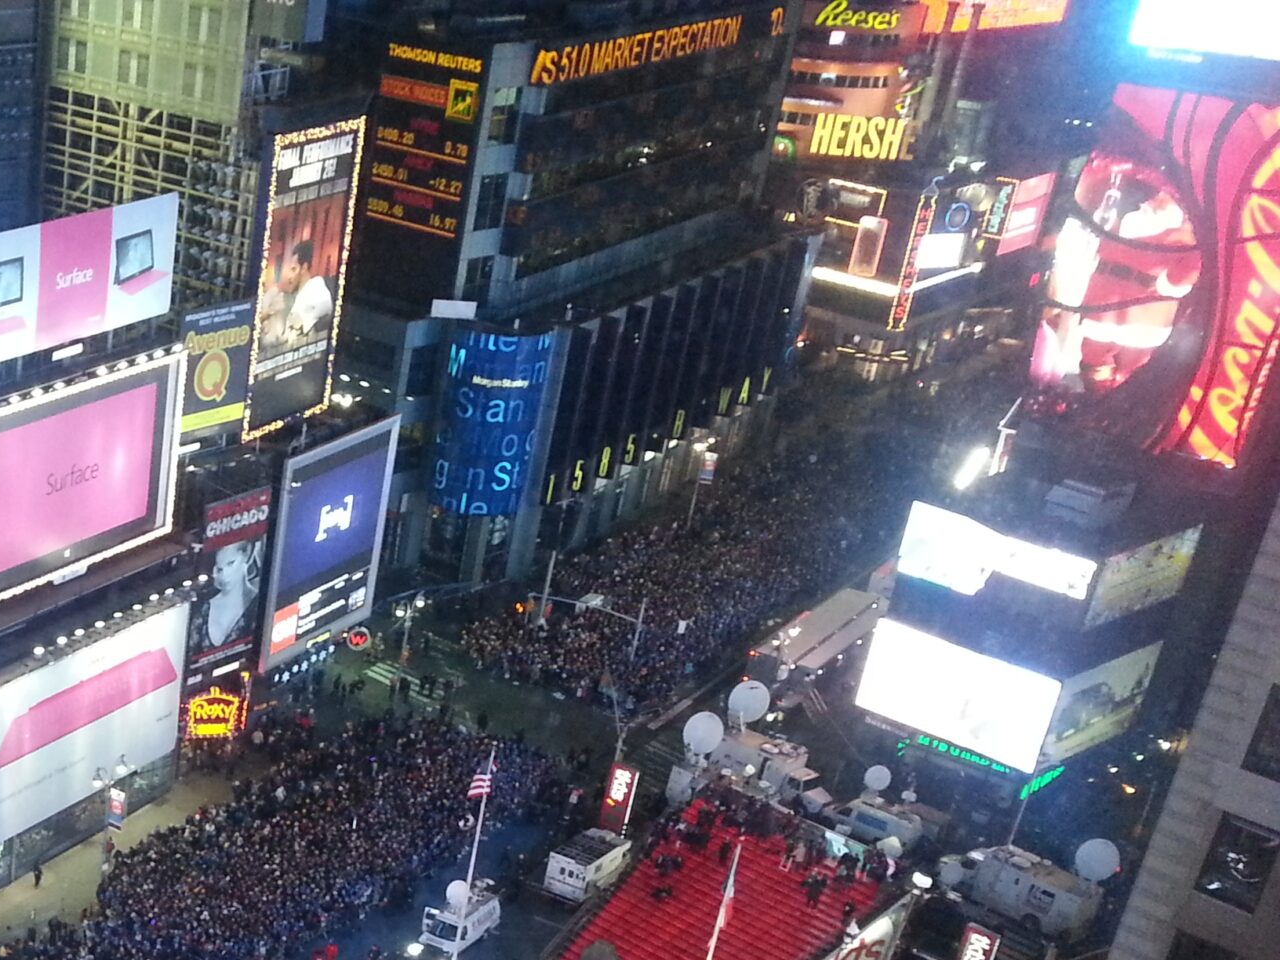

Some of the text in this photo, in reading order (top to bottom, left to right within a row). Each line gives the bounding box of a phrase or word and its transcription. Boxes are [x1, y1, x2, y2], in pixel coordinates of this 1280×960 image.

[815, 0, 900, 30] Reese's
[388, 43, 483, 74] THOMSON REUTERS
[559, 46, 590, 83] 51.0
[590, 32, 652, 75] MARKET
[651, 15, 743, 62] EXPECTATION
[55, 266, 94, 290] Surface
[186, 326, 251, 355] Avenue
[194, 350, 231, 403] Q
[44, 458, 100, 497] Surface
[205, 503, 269, 539] CHICAGO
